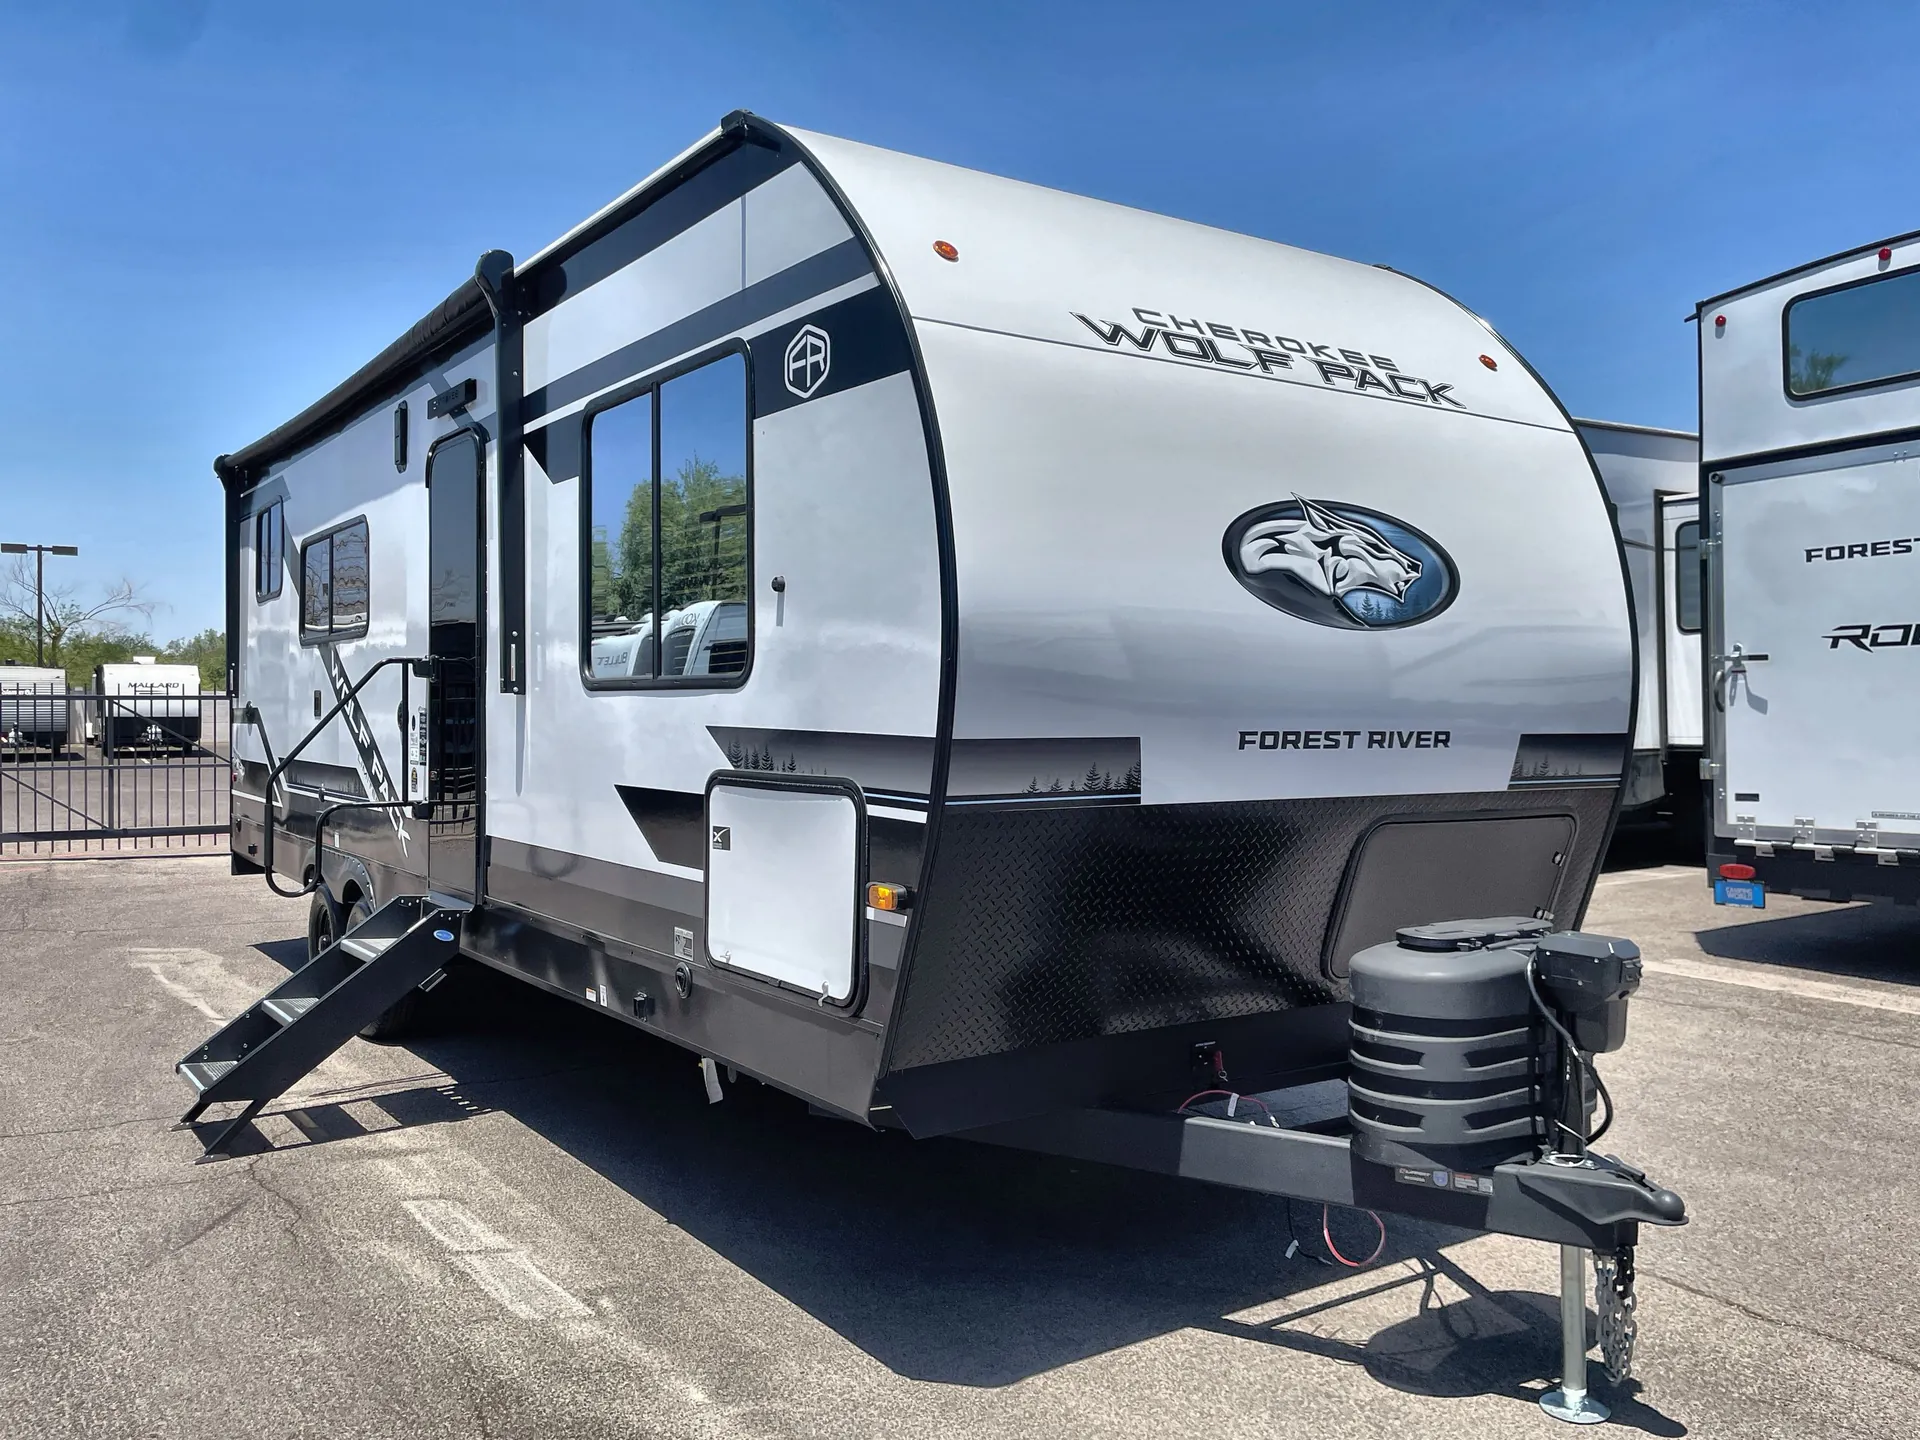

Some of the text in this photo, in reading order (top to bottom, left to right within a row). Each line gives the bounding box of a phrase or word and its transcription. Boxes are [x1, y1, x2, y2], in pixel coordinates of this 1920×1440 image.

[1069, 311, 1467, 409] WOLF PACK
[1131, 306, 1400, 371] CHEROKEE
[1237, 730, 1451, 750] FOREST RIVER
